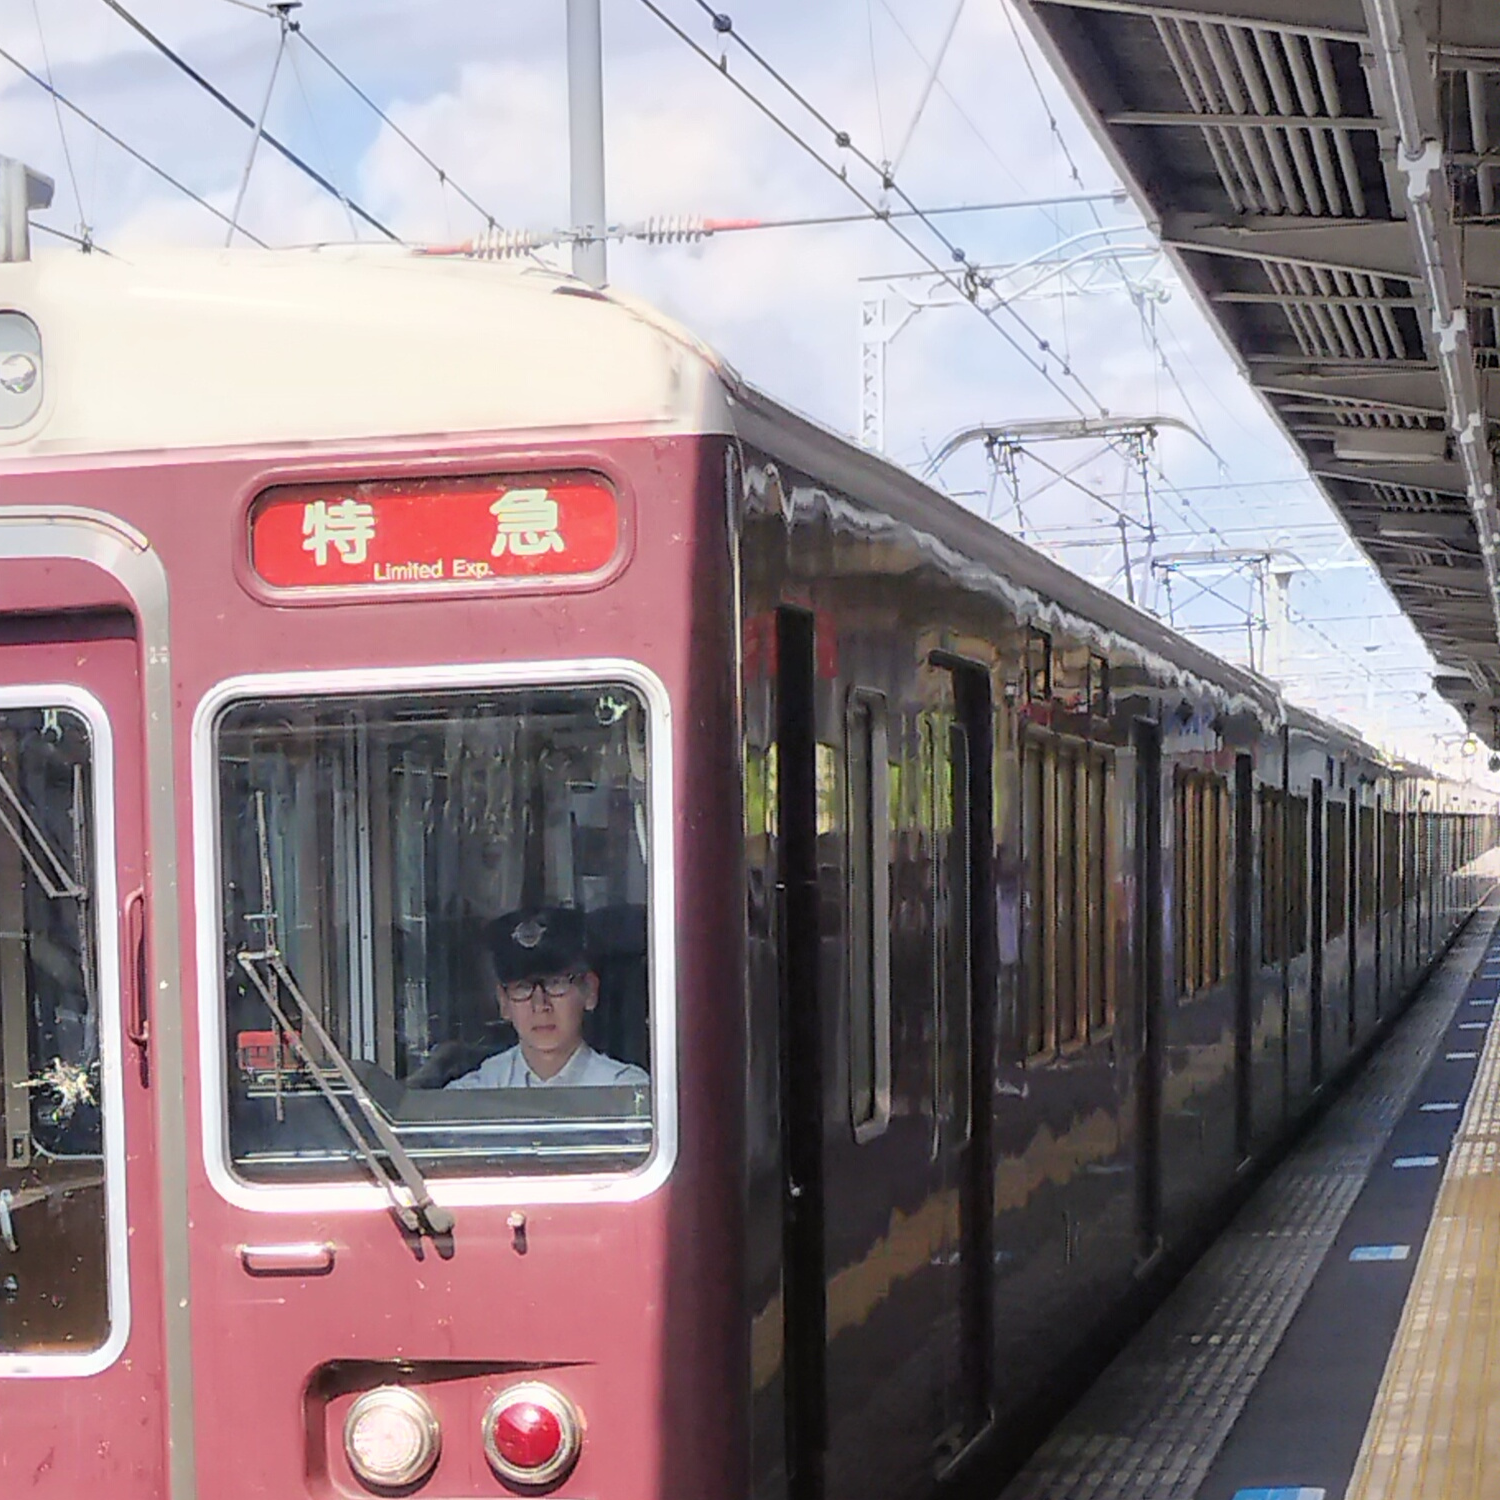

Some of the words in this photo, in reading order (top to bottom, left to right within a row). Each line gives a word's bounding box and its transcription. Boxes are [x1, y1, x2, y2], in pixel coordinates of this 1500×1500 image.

[301, 488, 566, 567] 特急
[373, 559, 444, 582] Limited
[452, 558, 494, 578] Exp.
